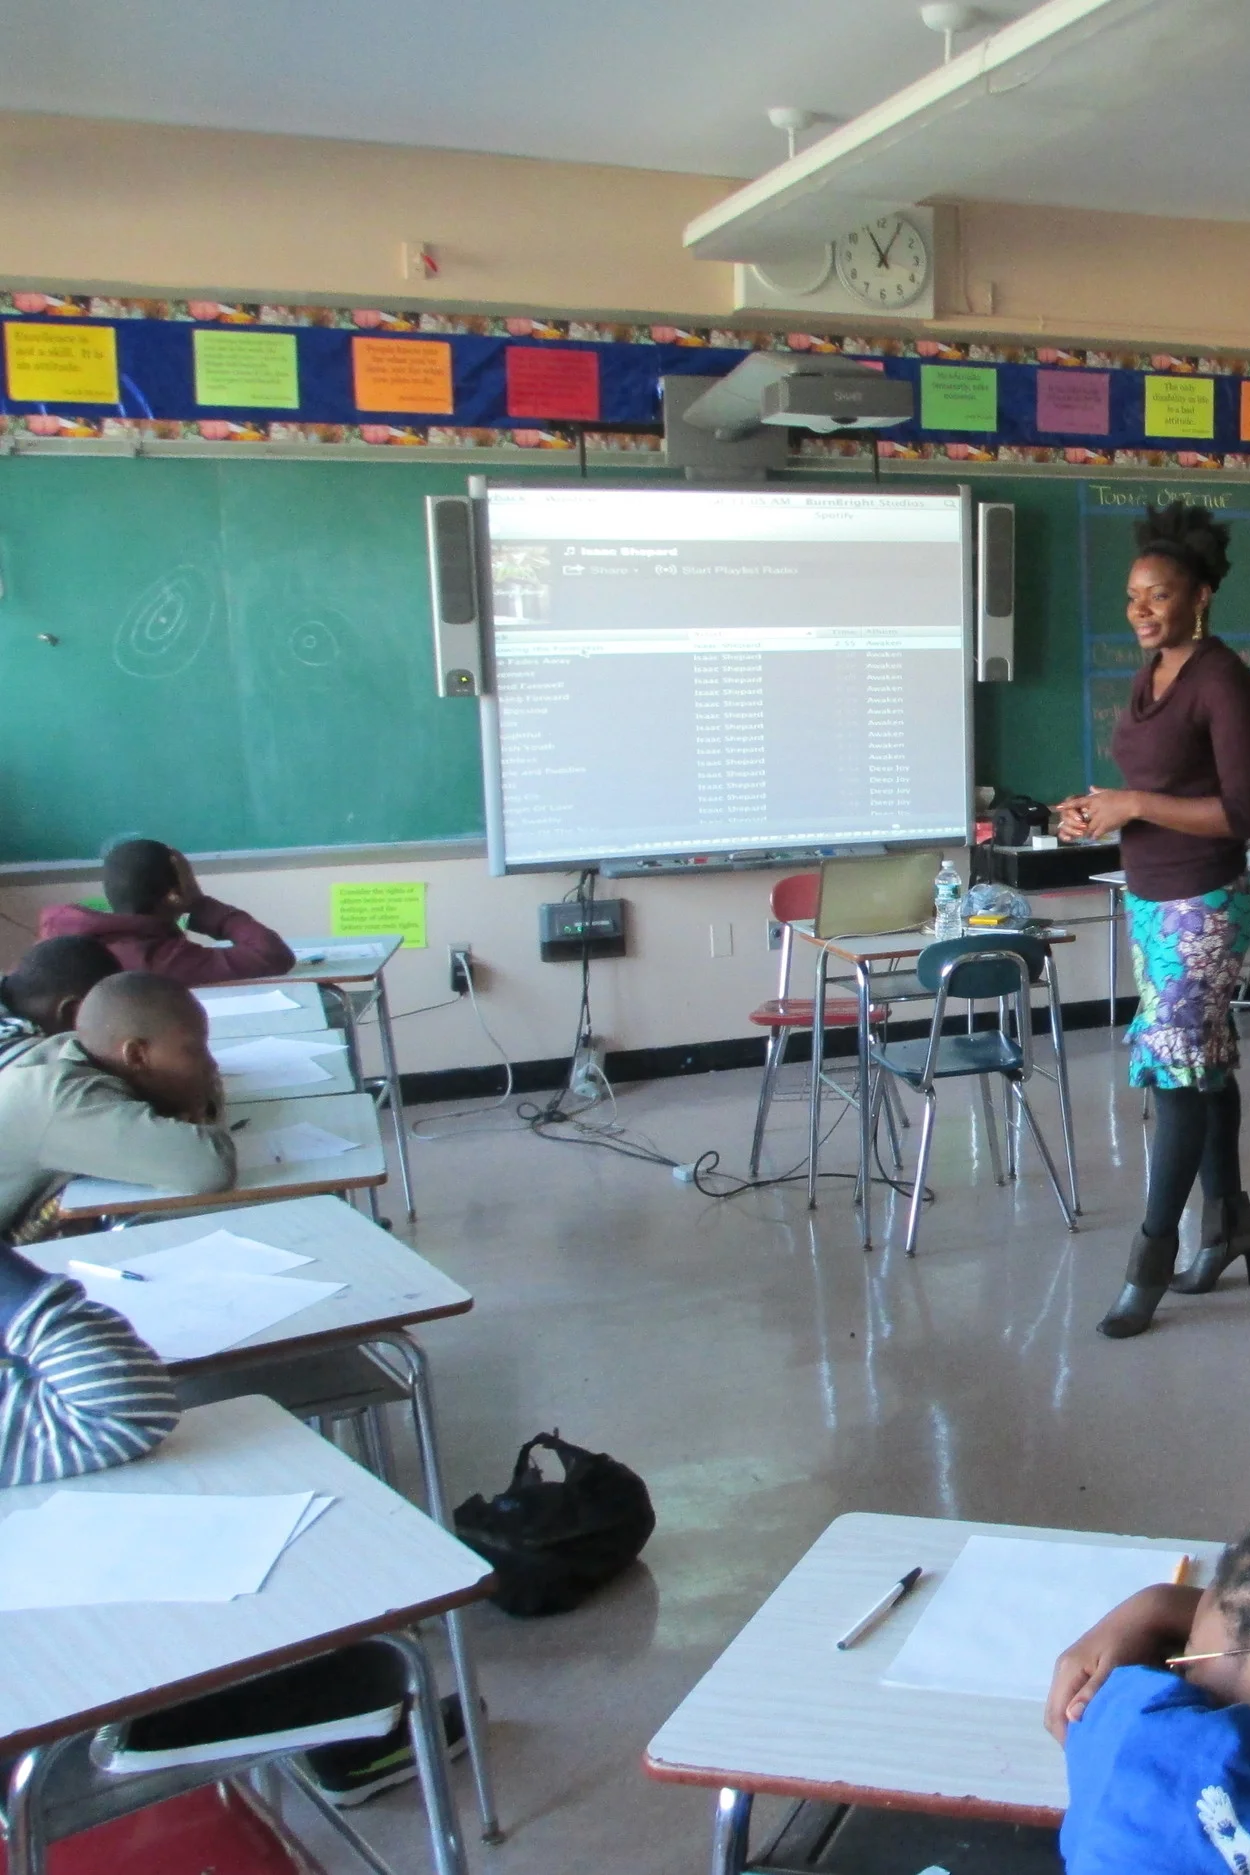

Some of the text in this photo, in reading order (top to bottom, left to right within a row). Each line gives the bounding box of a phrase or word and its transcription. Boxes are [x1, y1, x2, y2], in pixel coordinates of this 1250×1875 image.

[877, 218, 887, 228] 12
[848, 232, 858, 245] 10
[908, 238, 915, 249] 2
[846, 250, 852, 262] 9
[913, 256, 920, 267] 3
[850, 268, 858, 280] 8
[909, 273, 916, 284] 4
[864, 281, 870, 293] 7
[896, 283, 904, 296] 5
[880, 288, 887, 300] 6
[15, 331, 90, 345] Excellence is
[16, 347, 35, 356] not
[81, 348, 91, 360] It
[94, 348, 104, 360] is
[16, 363, 31, 371] an
[1164, 382, 1195, 393] The only
[1152, 392, 1186, 404] disability
[1197, 395, 1209, 404] life
[1167, 405, 1173, 413] is
[1181, 405, 1195, 414] bad
[805, 498, 874, 509] BurnBright
[879, 498, 925, 508] Studios
[814, 511, 854, 521] Spotify
[581, 546, 679, 558] Isaac Shepard
[590, 565, 798, 577] Share Start Playlist Radio
[693, 654, 718, 662] Isaac
[722, 653, 762, 662] Shepard
[693, 666, 718, 674] Isaac
[722, 664, 762, 673] Shepard
[694, 677, 718, 685] Isaac
[722, 676, 763, 685] Shepard
[694, 689, 719, 697] Isaac
[723, 688, 763, 697] Shepard
[723, 699, 764, 708] Shepard
[695, 712, 720, 720] Isaac
[724, 711, 764, 720] Shepard
[696, 724, 720, 732] Isaac
[724, 723, 765, 732] Shepard
[725, 734, 765, 743] Shepard
[697, 747, 721, 755] Isaac
[725, 746, 766, 755] Shepard
[697, 759, 721, 767] Isaac
[725, 757, 766, 766] Shepard
[697, 765, 910, 778] Isaac Shepard Deep Joy
[698, 777, 910, 790] Isaac Shepard Deep Joy
[727, 792, 767, 801] Shepard
[870, 788, 894, 796] Deep
[896, 788, 911, 796] Joy
[870, 799, 911, 807] Deep Joy
